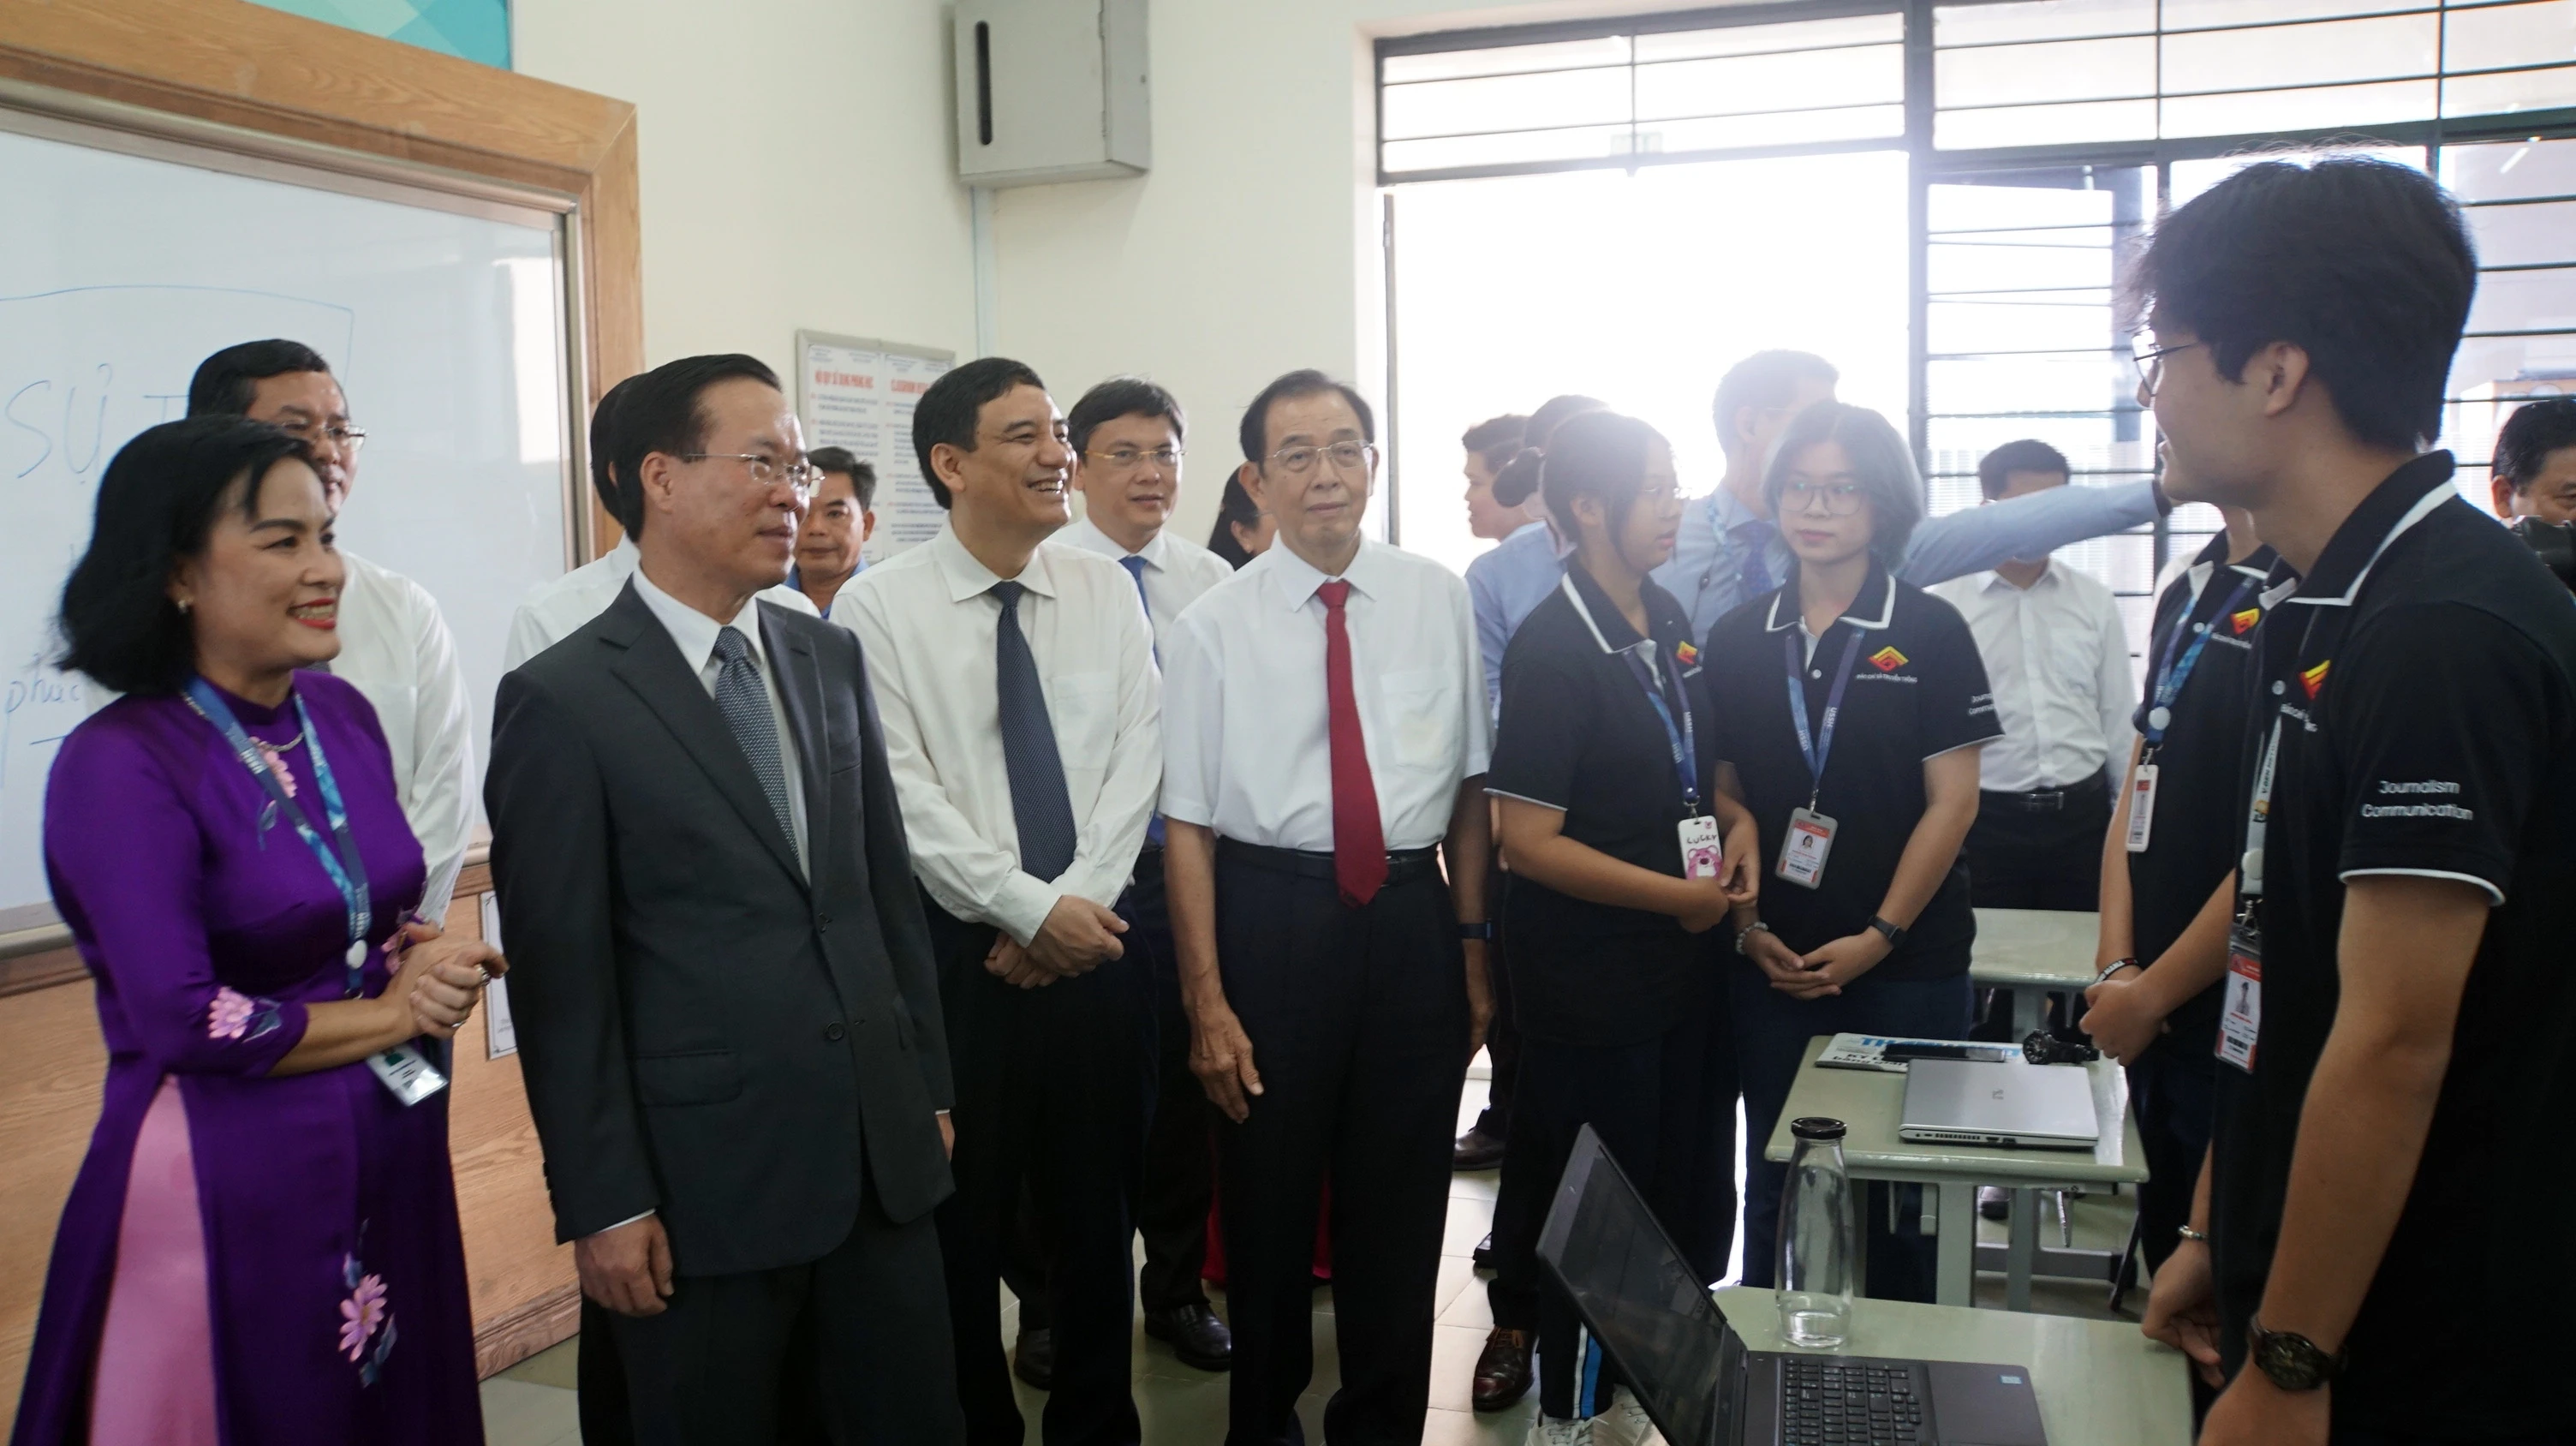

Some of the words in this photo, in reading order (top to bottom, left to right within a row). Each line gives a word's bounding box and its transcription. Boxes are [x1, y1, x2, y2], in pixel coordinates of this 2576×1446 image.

[1827, 707, 1838, 727] USSH
[2379, 780, 2460, 794] Journalism
[2362, 803, 2473, 821] Communication
